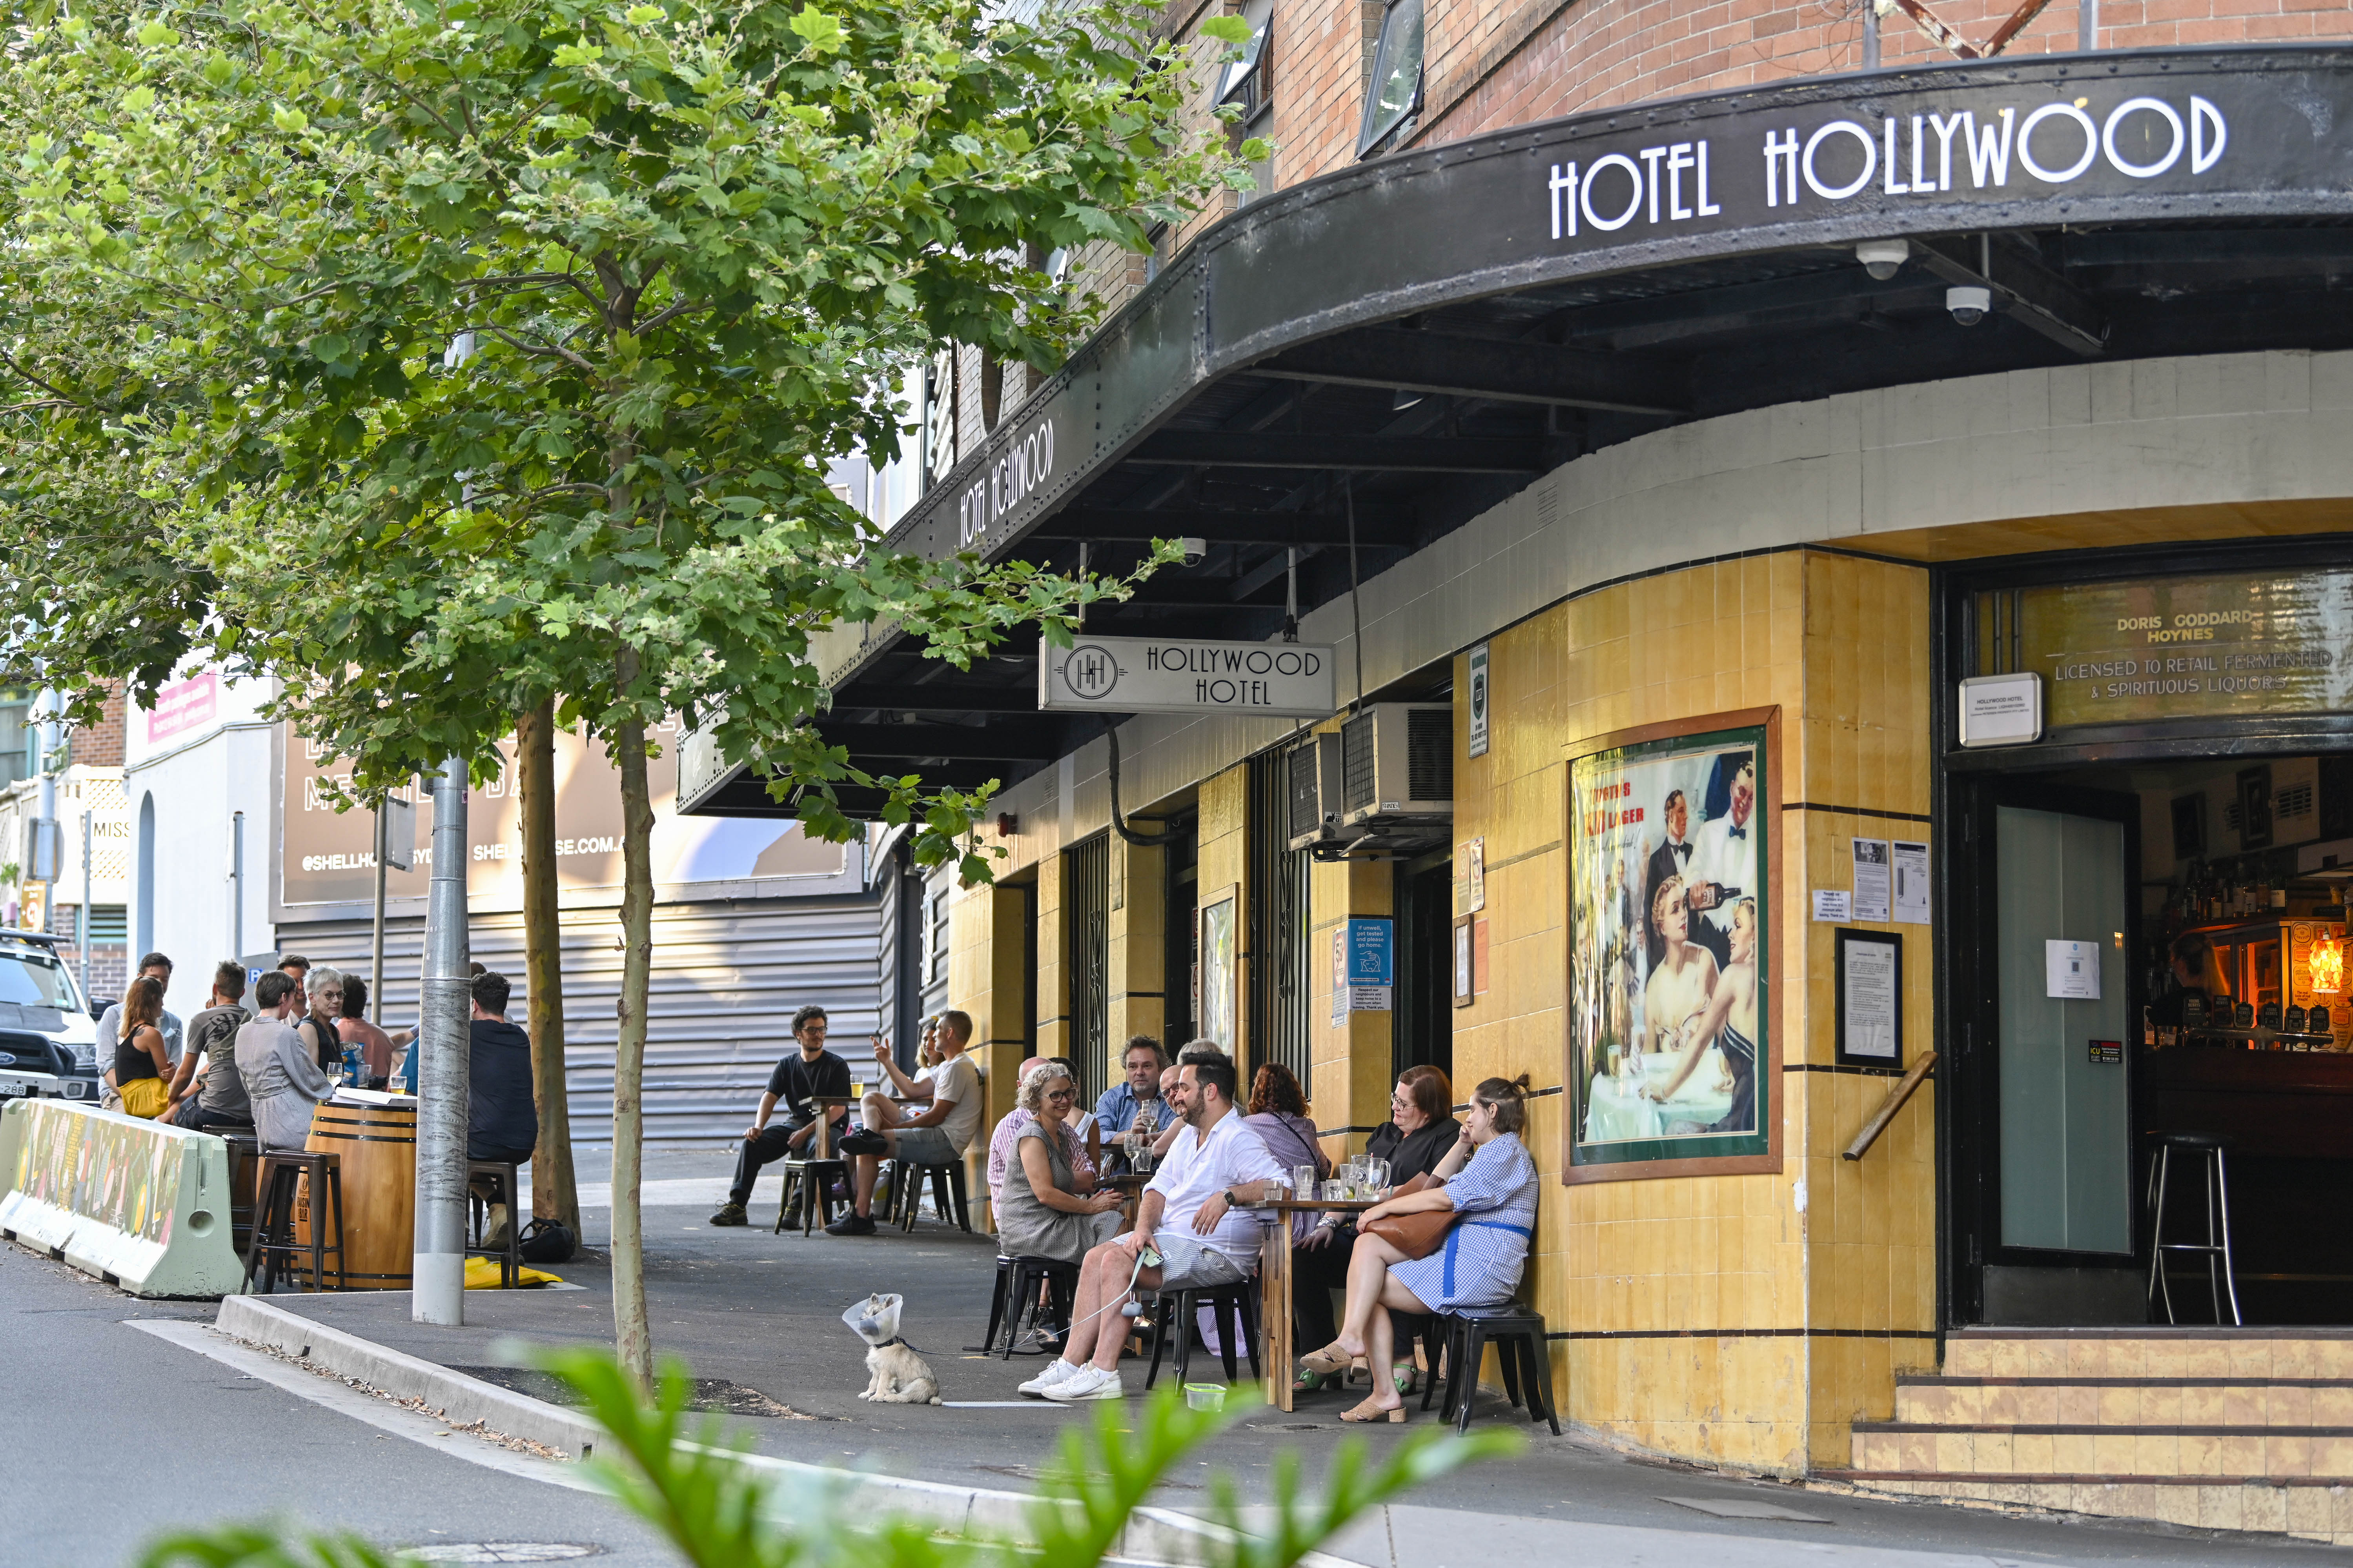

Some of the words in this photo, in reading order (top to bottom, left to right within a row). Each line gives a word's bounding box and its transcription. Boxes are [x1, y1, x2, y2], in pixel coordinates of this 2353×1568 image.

[1549, 140, 1720, 240] HOTEL
[1764, 95, 2227, 207] HOLLYWOOD
[960, 478, 986, 549] HOTEL
[991, 418, 1054, 524] HOLLYWOOD
[2118, 616, 2162, 631] DORIS
[2174, 610, 2253, 628] GODDARD
[2147, 628, 2214, 643] HOYNES
[1147, 647, 1320, 677] HOLLYWOOD
[2055, 661, 2137, 680] LICENSED
[2144, 660, 2160, 674] TO
[2166, 656, 2217, 673] RETAIL
[2224, 651, 2333, 670] FERMENTED
[1197, 679, 1271, 705] HOTEL
[2091, 686, 2099, 699] &
[2107, 678, 2199, 698] SPIRITUOUS
[2207, 675, 2287, 693] LIQUORS
[1608, 808, 1644, 829] LAGER
[251, 970, 260, 982] P
[299, 1208, 308, 1219] BAR
